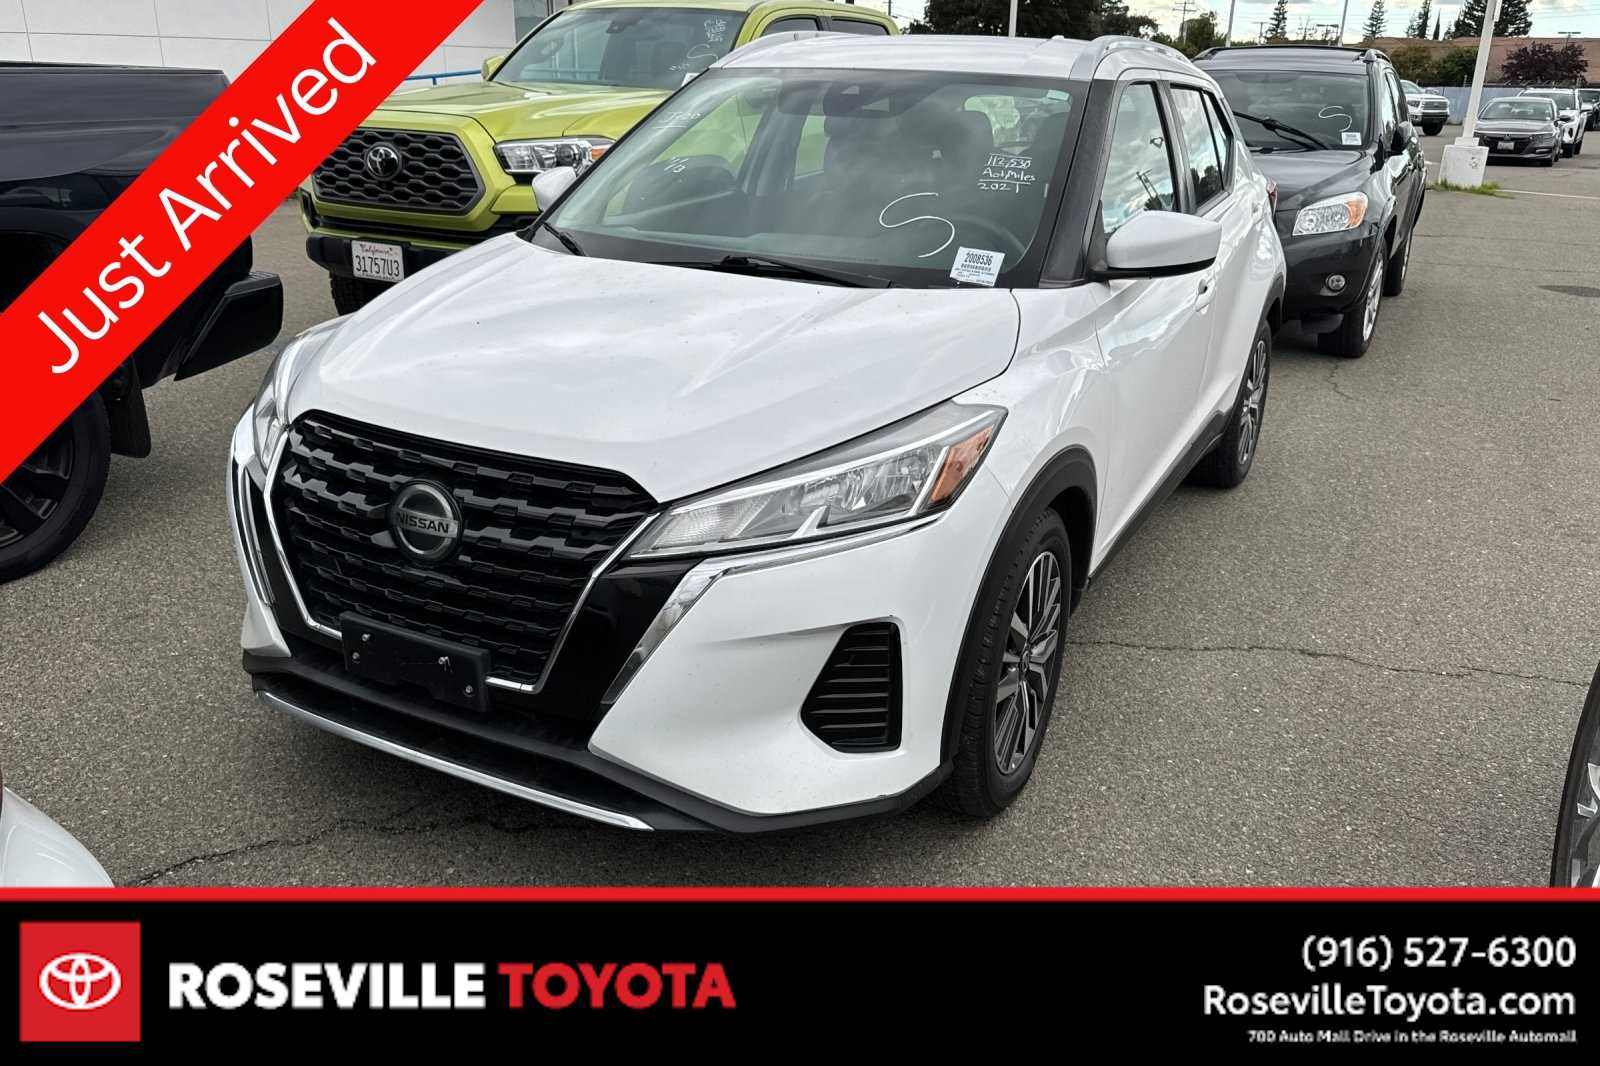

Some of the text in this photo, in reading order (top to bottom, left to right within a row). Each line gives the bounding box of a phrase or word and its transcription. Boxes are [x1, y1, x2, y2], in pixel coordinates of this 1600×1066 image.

[977, 182, 1020, 194] 2021
[879, 192, 955, 258] S
[355, 254, 400, 277] 31757U3
[964, 252, 993, 266] 2008536
[398, 510, 449, 534] NISSAN
